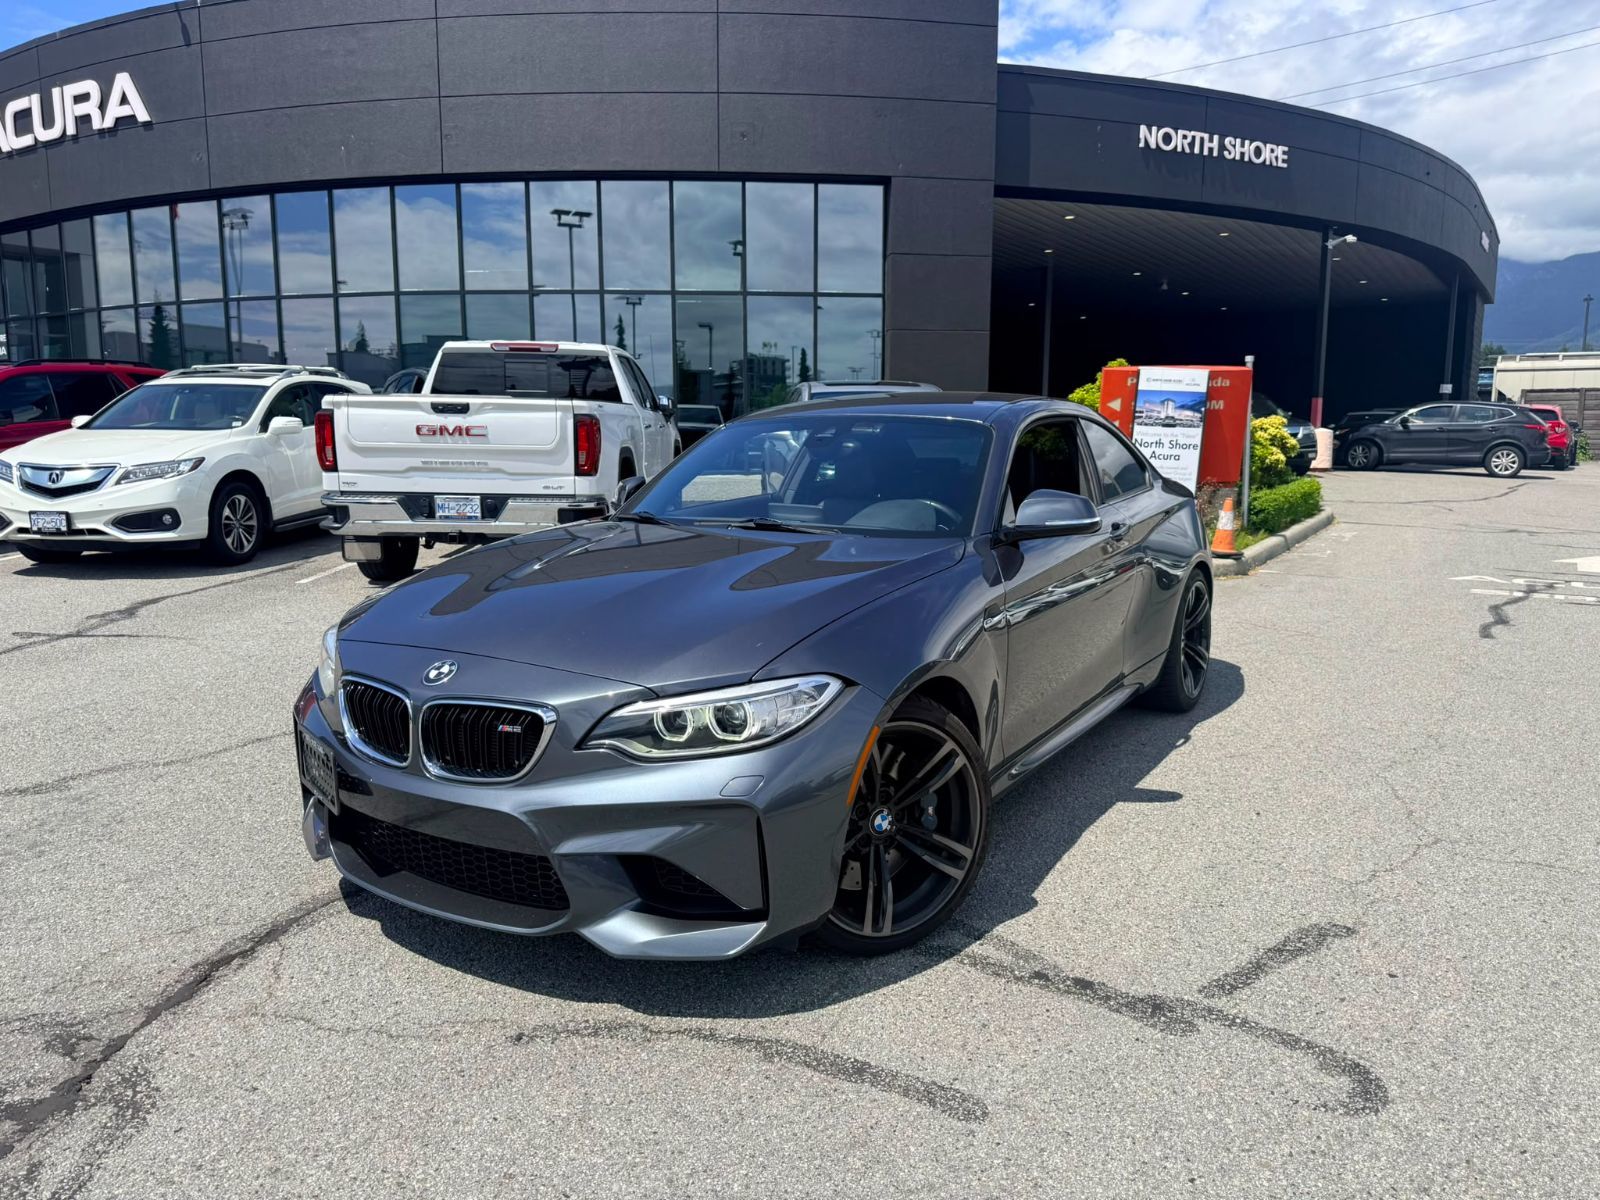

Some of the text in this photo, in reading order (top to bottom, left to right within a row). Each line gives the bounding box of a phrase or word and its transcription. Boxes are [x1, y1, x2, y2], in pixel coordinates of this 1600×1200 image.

[1138, 124, 1289, 168] NORTH SHORE
[415, 424, 488, 437] GMC
[1134, 437, 1199, 451] North Shore
[1149, 450, 1181, 461] Acura
